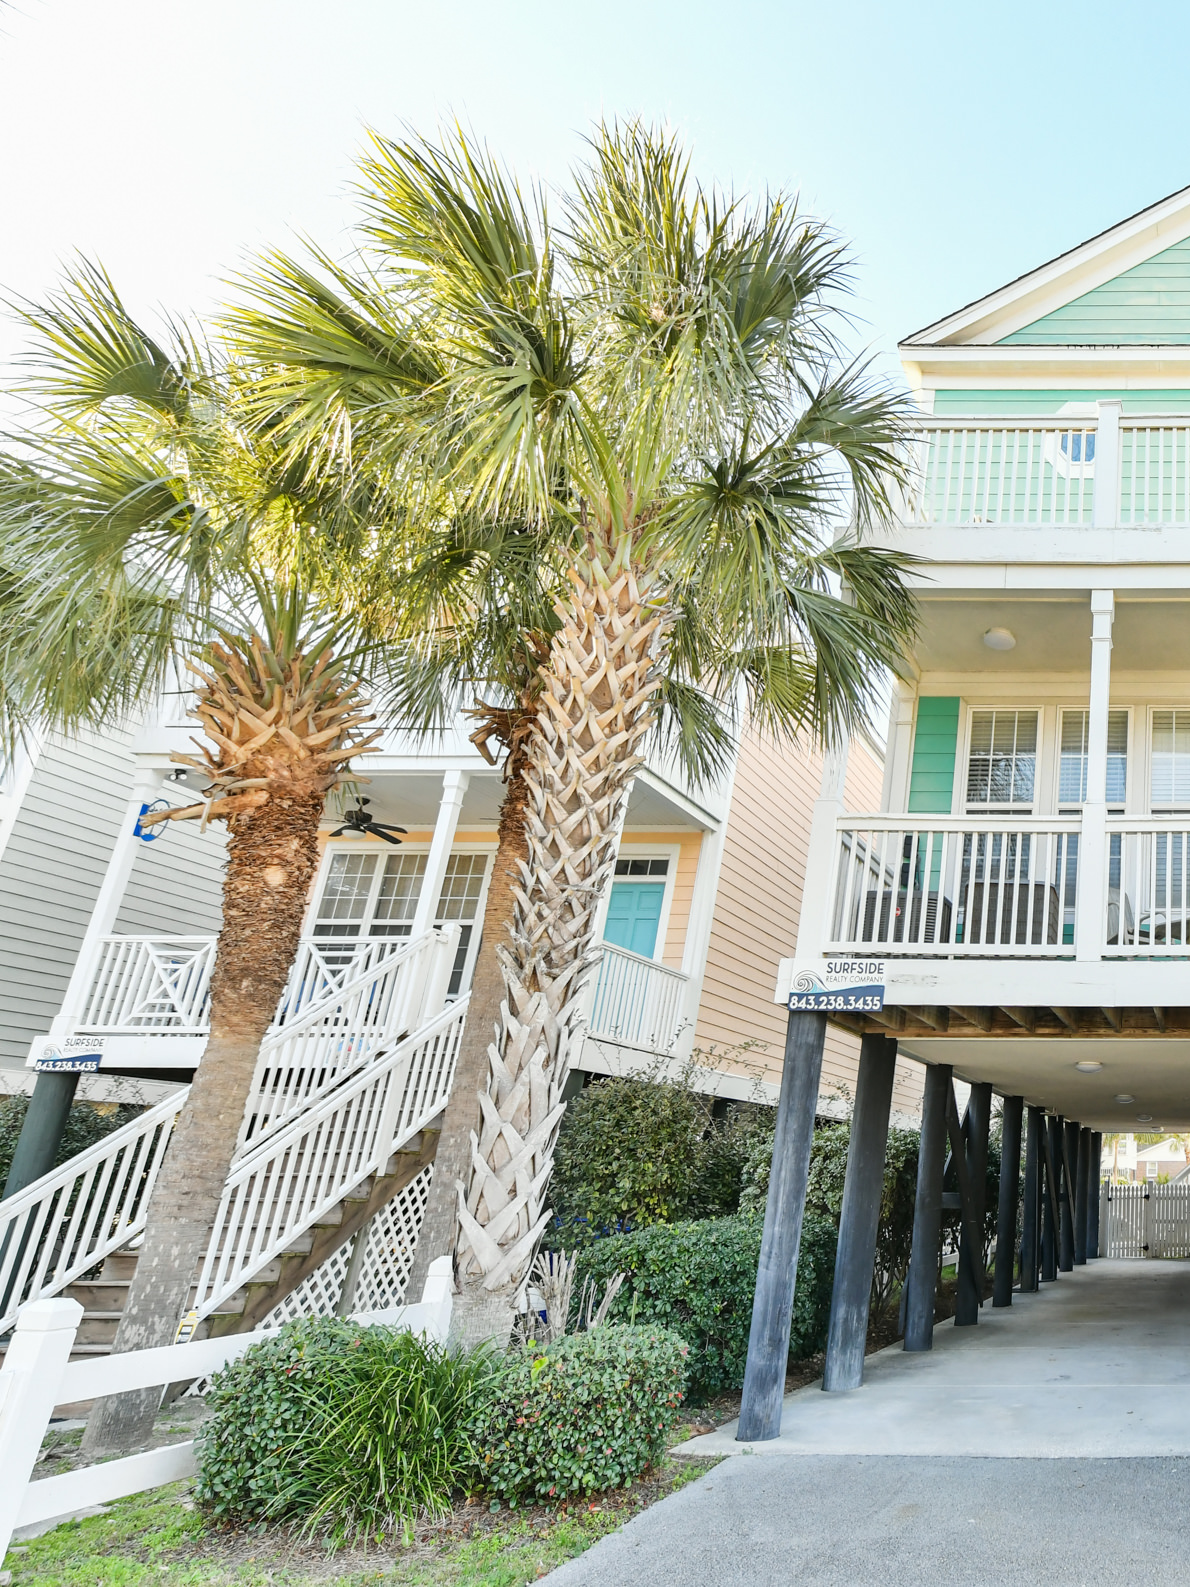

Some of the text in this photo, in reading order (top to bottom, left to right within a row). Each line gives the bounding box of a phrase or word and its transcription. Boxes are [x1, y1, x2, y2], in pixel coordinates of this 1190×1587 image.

[826, 962, 885, 974] SURFSIDE
[826, 975, 884, 983] REALTY COMPANY
[789, 995, 881, 1010] 843.238.3435
[64, 1038, 105, 1047] SURFSIDE
[35, 1061, 98, 1071] 843.238.3435
